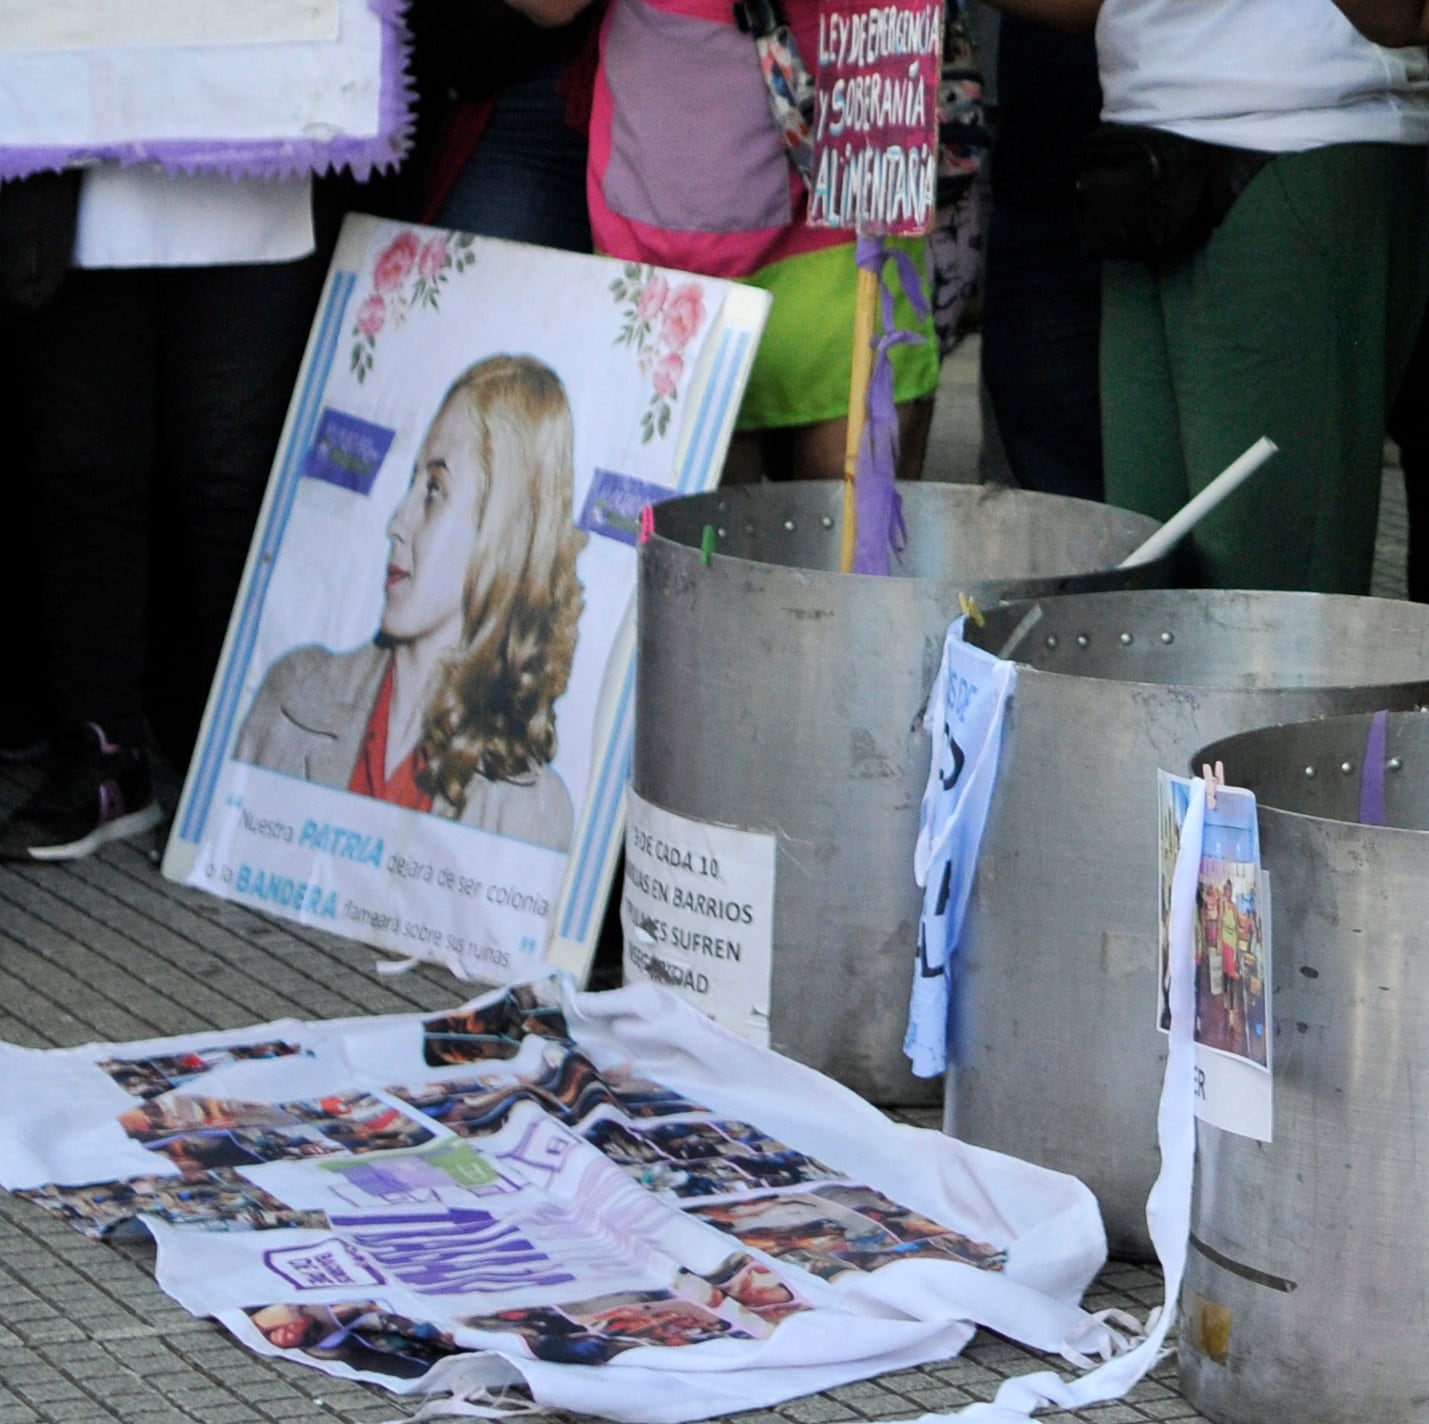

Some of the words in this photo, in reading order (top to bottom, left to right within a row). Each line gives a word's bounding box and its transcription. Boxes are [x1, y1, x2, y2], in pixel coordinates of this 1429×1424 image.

[819, 12, 850, 69] LEY
[847, 13, 868, 68] DE
[816, 89, 829, 142] Y
[830, 59, 926, 136] SOBERANÍA
[811, 142, 937, 228] ALIMENTARIA
[239, 808, 294, 843] Nuestra
[298, 819, 385, 868] PATRIA
[437, 867, 456, 888] de
[455, 874, 480, 897] ser
[486, 883, 550, 917] colonia
[655, 838, 693, 874] CADA
[701, 854, 719, 879] 10
[235, 863, 339, 919] BANDERA
[402, 918, 443, 947] sobre
[445, 933, 465, 954] sus
[467, 939, 511, 969] ruinas
[673, 885, 754, 925] BARRIOS
[672, 924, 742, 963] SUFREN
